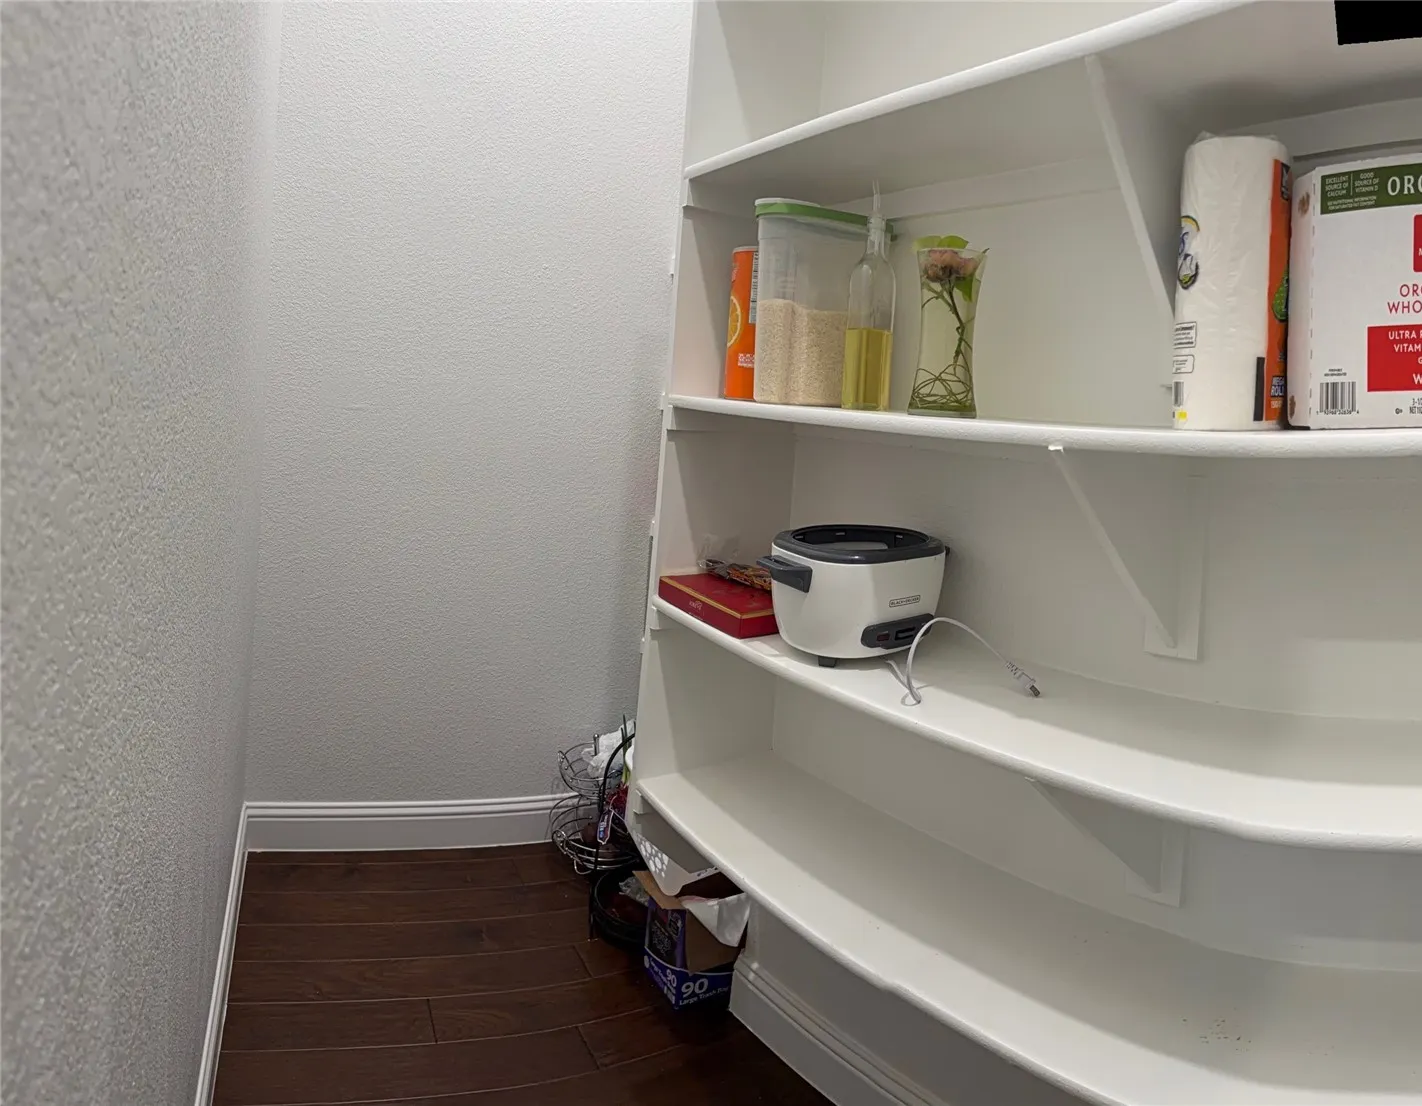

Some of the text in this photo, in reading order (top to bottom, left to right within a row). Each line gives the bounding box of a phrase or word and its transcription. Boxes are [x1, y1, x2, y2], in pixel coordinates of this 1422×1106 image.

[1325, 175, 1349, 185] EXCELLENT
[1325, 182, 1342, 191] SOURCE
[1388, 330, 1417, 340] ULTRA
[666, 969, 677, 987] 90
[681, 978, 709, 998] 90
[680, 996, 698, 1006] Large
[698, 990, 717, 999] Trash
